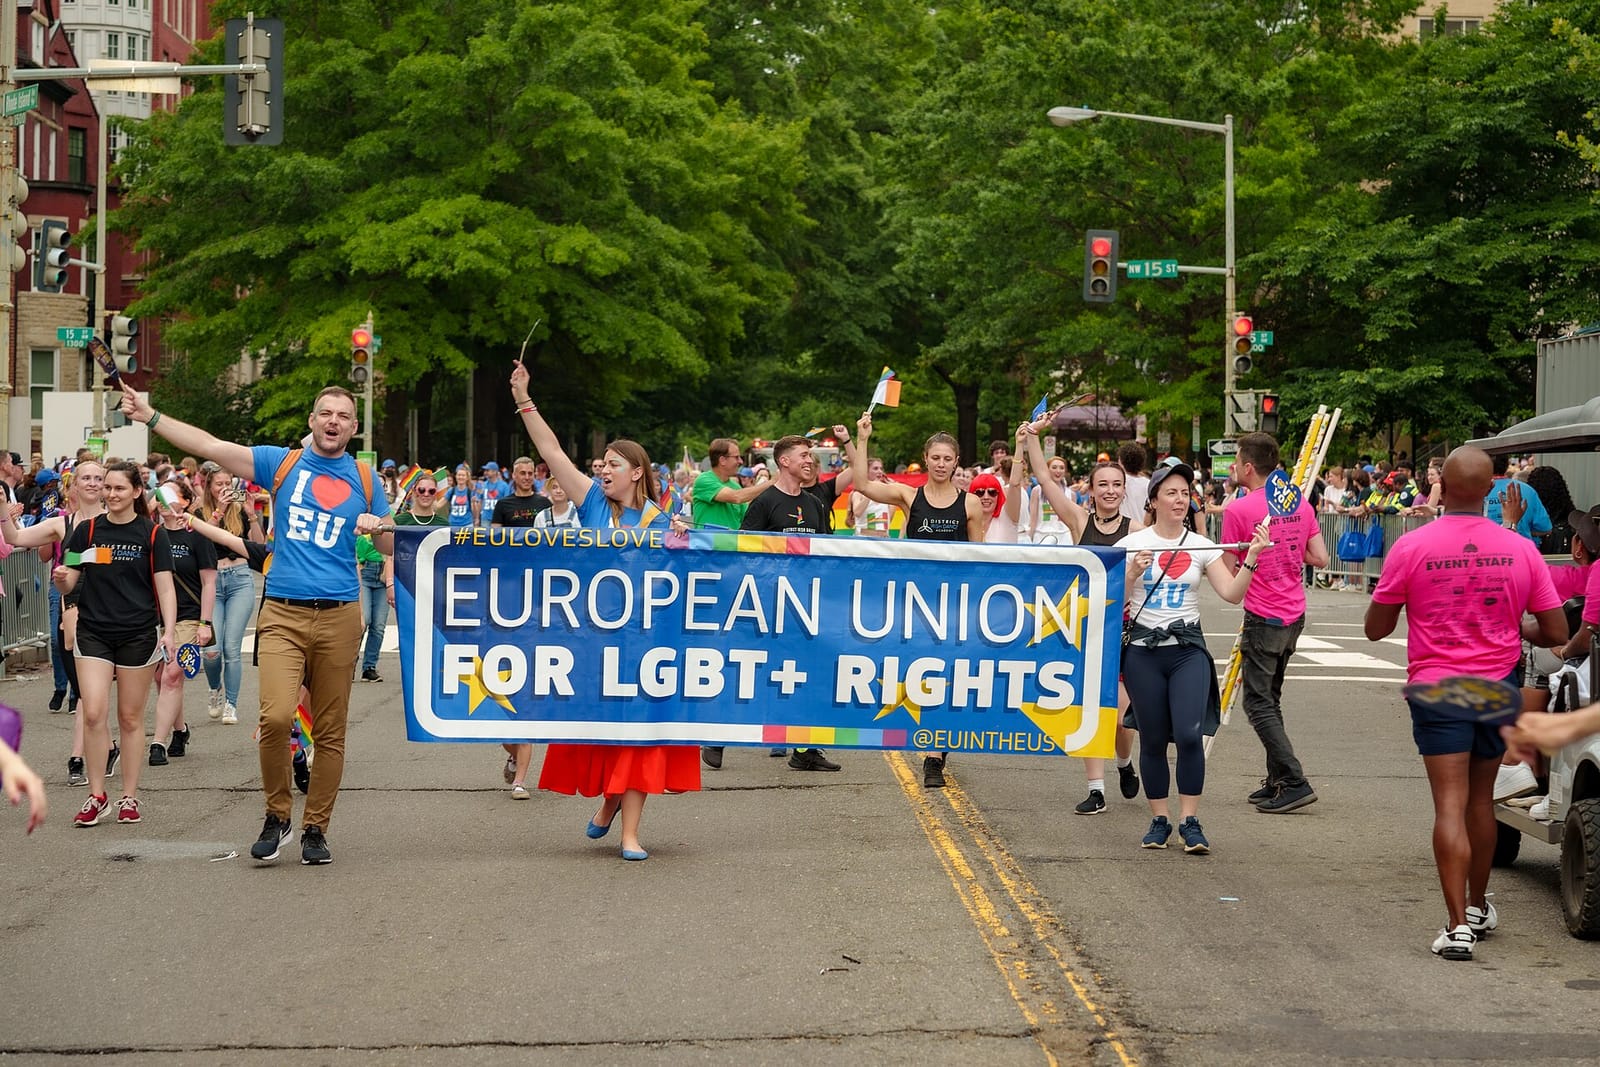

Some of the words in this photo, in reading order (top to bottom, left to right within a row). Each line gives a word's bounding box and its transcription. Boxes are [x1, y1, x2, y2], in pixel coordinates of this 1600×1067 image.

[1129, 264, 1141, 273] NW
[1144, 261, 1162, 276] 15
[1165, 264, 1176, 273] ST
[66, 329, 74, 339] 15
[1222, 443, 1236, 452] ONE
[290, 469, 312, 505] I
[286, 505, 346, 549] EU
[454, 527, 663, 549] #EULOVESLOVE
[117, 550, 141, 559] DANCE
[1426, 560, 1469, 571] EVENT
[1476, 557, 1514, 567] STAFF
[445, 567, 821, 636] EUROPEAN
[852, 578, 1079, 645] UNION
[1143, 583, 1190, 609] EU
[442, 644, 575, 696] FOR
[603, 646, 807, 700] LGBT+
[836, 654, 1076, 710] RIGHTS
[912, 729, 1056, 752] @EUINTHEUS
